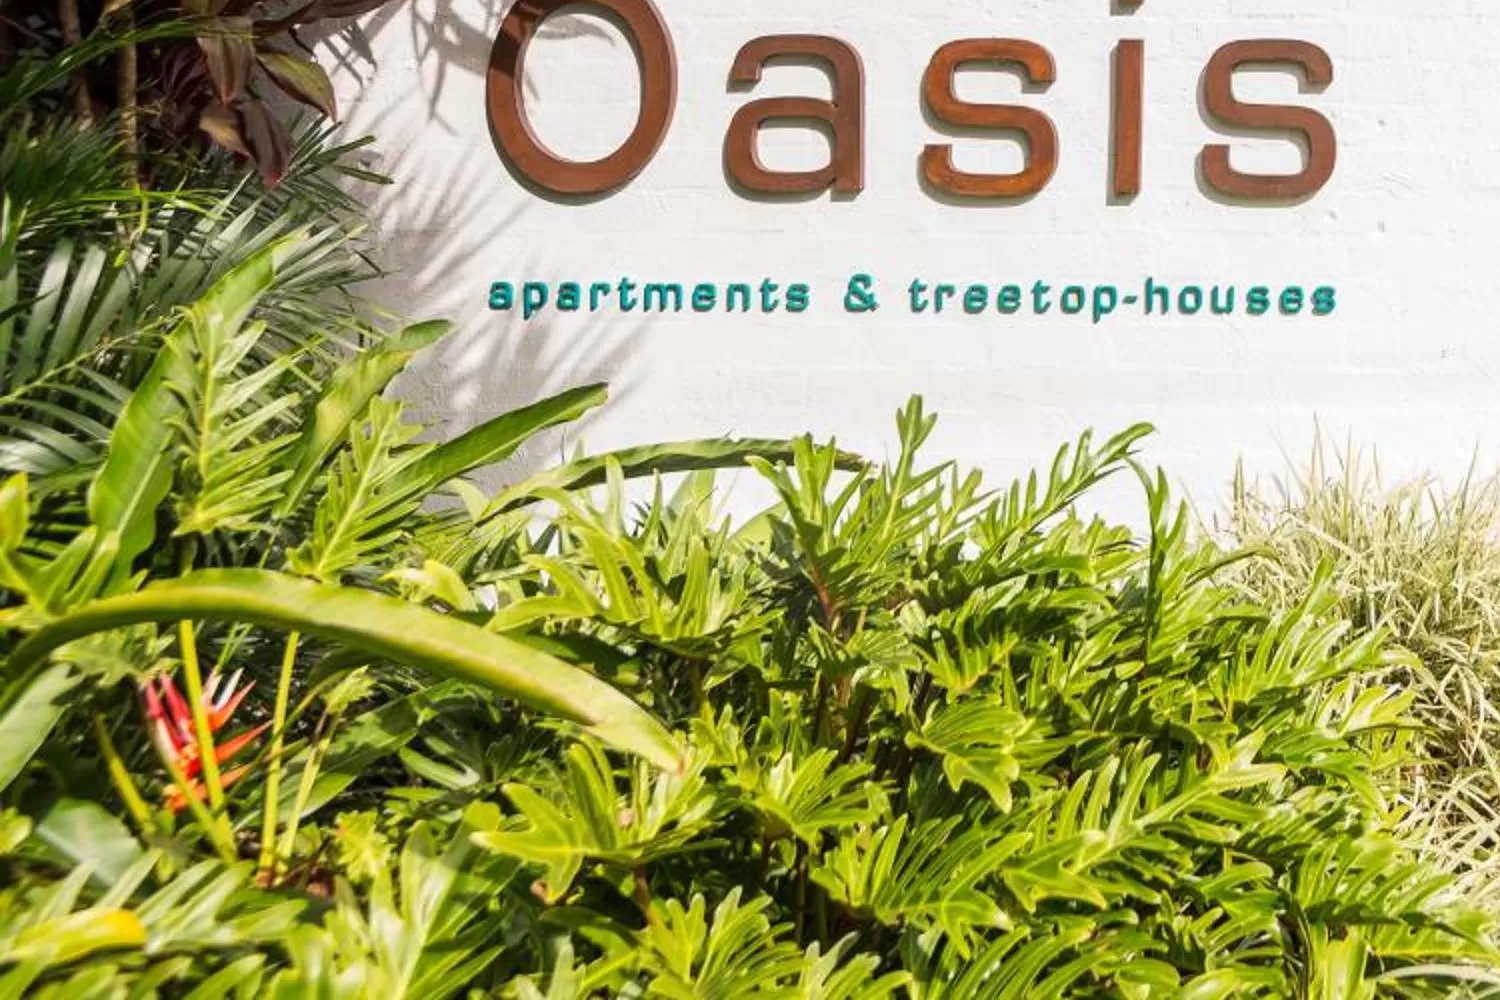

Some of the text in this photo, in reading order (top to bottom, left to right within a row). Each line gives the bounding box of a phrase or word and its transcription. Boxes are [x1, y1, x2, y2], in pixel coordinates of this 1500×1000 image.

[487, 272, 1337, 324] apartments & treetop-houses
